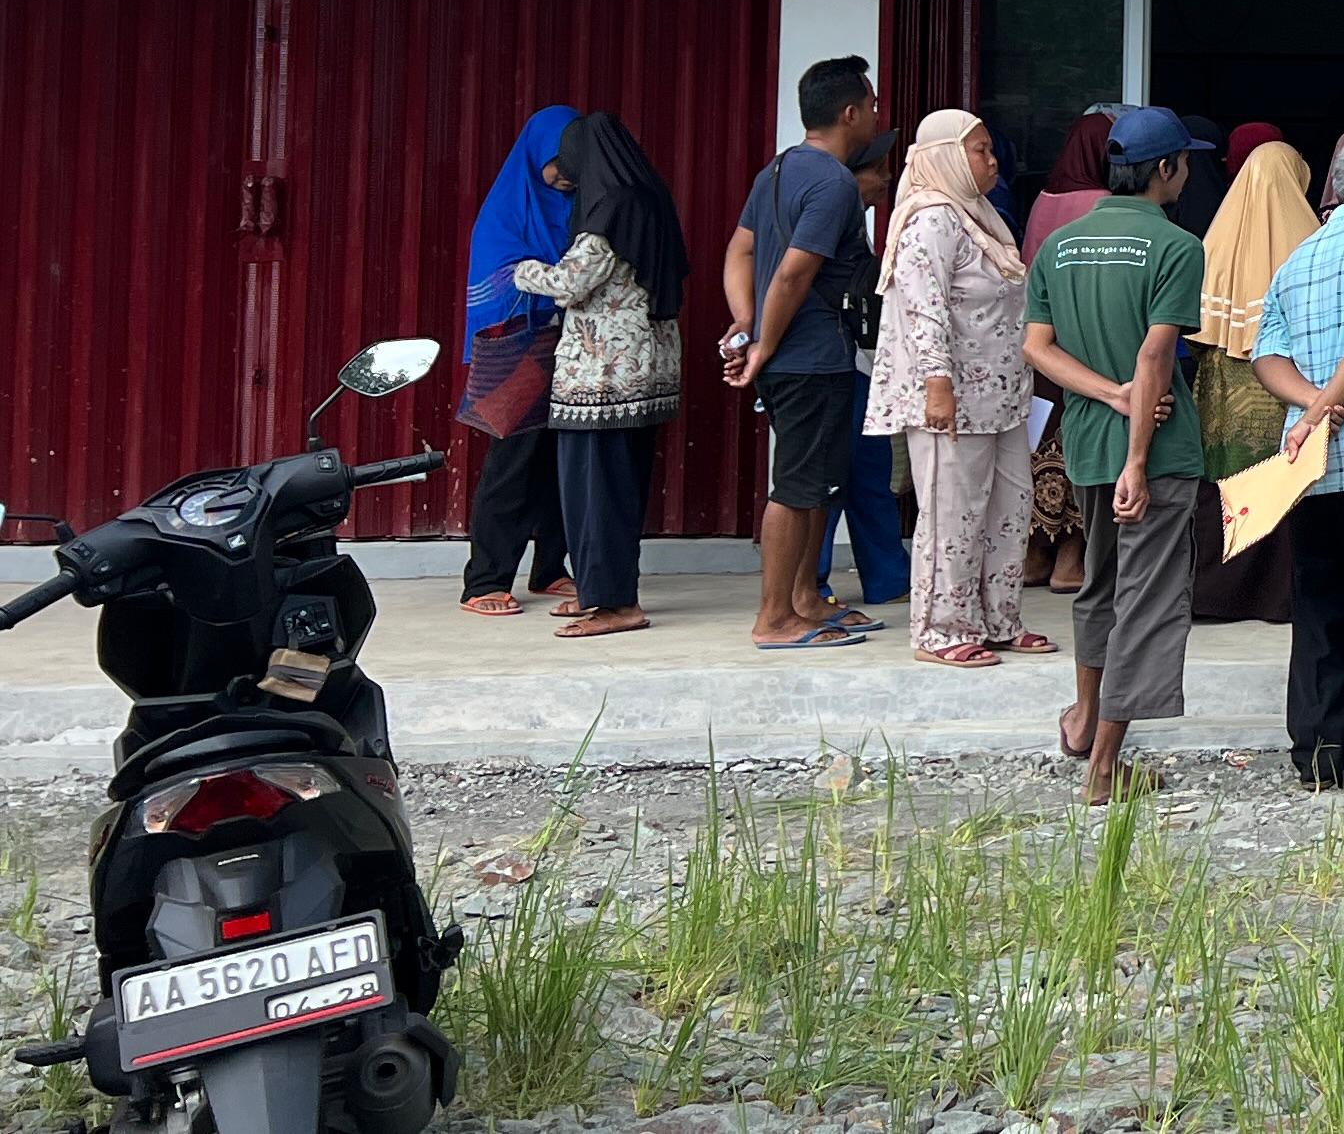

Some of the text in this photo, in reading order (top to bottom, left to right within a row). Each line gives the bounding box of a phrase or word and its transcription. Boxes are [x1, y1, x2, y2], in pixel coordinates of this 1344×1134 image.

[1081, 246, 1095, 254] the
[1097, 246, 1117, 255] right
[1119, 246, 1147, 256] things
[138, 934, 375, 1016] AA 5620 AFD
